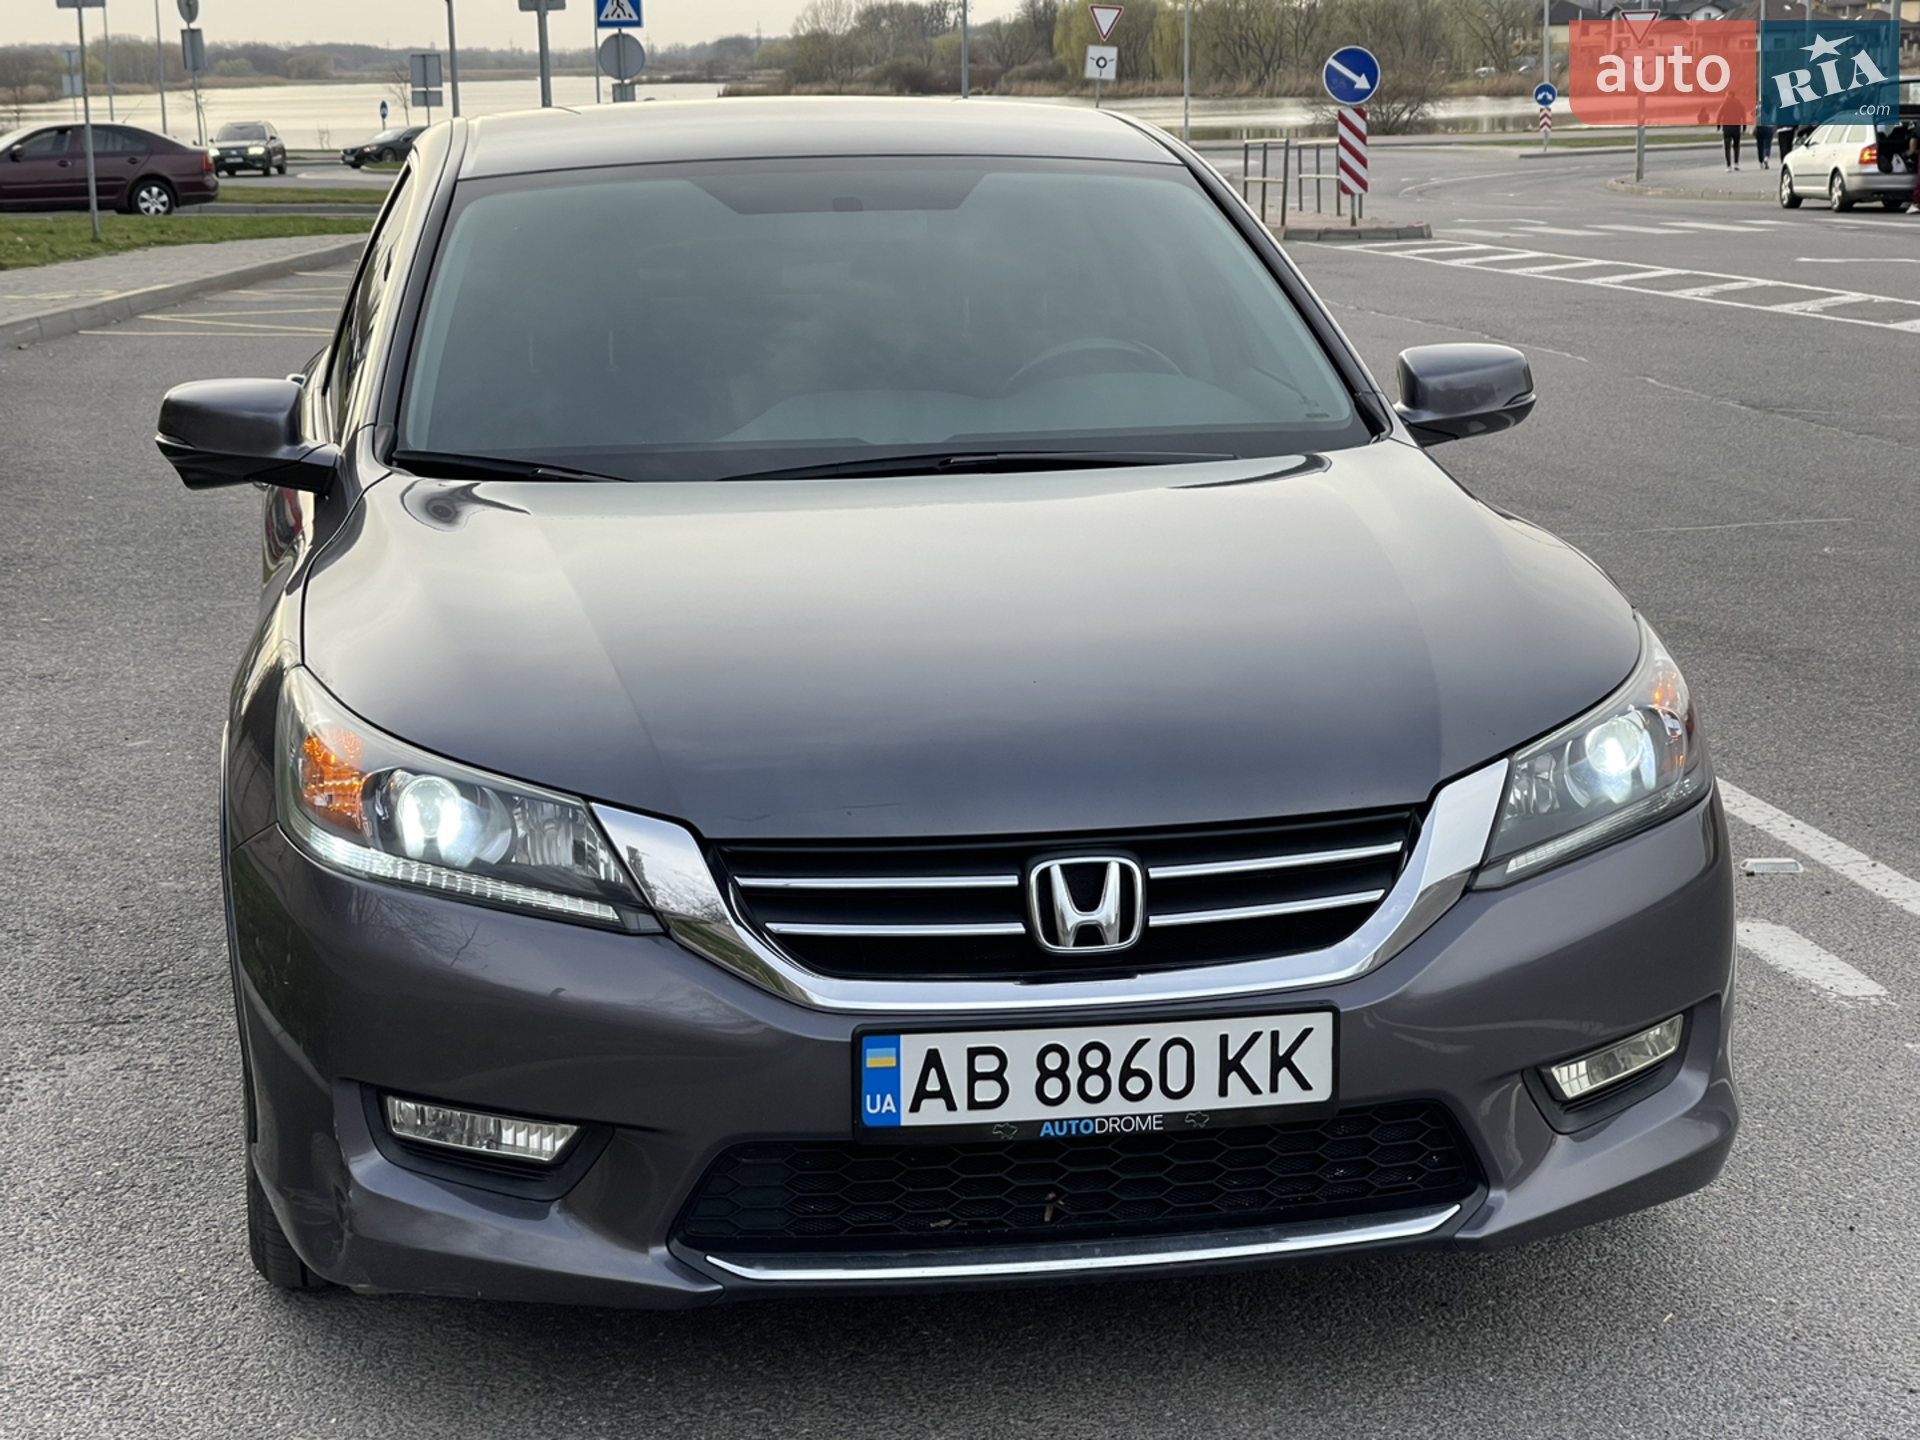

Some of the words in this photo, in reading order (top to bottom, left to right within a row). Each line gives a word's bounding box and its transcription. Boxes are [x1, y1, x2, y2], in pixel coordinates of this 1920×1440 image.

[908, 1045, 1010, 1113] AB
[1035, 1036, 1196, 1106] 8860
[1218, 1026, 1315, 1098] KK
[866, 1093, 897, 1115] UA
[1040, 1114, 1164, 1137] AUTODROME
